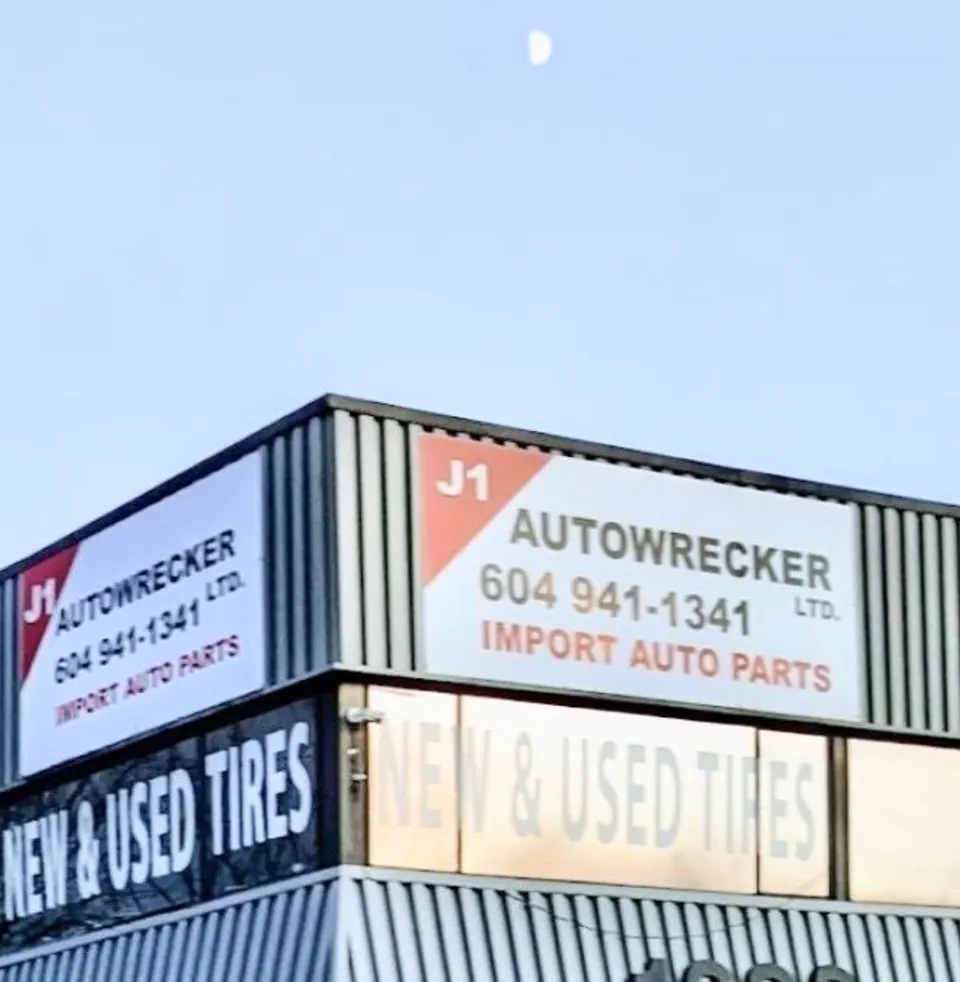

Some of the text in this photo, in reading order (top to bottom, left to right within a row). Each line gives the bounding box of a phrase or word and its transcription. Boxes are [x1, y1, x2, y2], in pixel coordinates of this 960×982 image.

[436, 459, 490, 501] J1
[56, 529, 236, 636] AUTOWRECKER
[206, 571, 246, 601] LTD.
[510, 507, 832, 591] AUTOWRECKER
[23, 578, 56, 623] J1
[480, 563, 751, 636] 604 941-1341
[794, 596, 841, 621] LTD.
[54, 598, 200, 684] 604 941-1341
[55, 635, 241, 725] IMPORT AUTO PARTS
[481, 620, 831, 694] IMPORT AUTO PARTS
[3, 722, 312, 921] NEW & USED TIRES
[511, 731, 543, 838] &
[561, 736, 681, 850] USED
